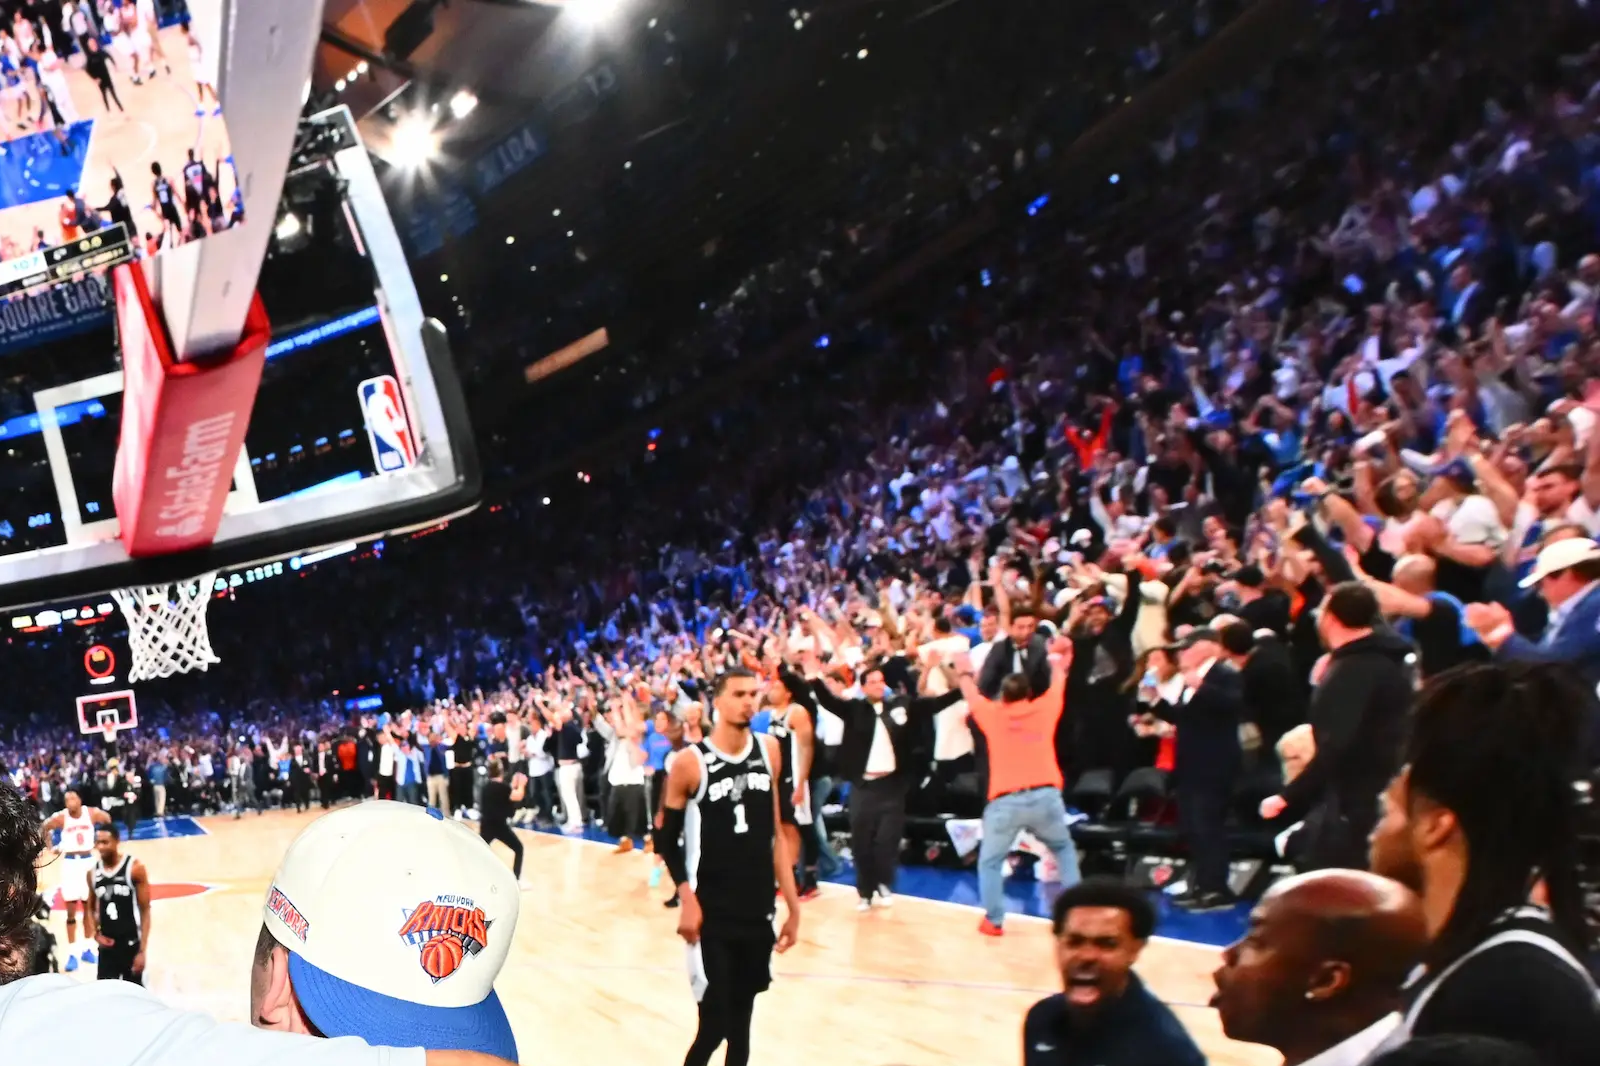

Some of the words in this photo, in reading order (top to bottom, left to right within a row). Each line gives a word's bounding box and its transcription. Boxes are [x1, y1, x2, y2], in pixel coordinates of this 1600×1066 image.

[733, 804, 749, 834] 1
[436, 895, 454, 904] NEW
[398, 901, 488, 948] KNICKS
